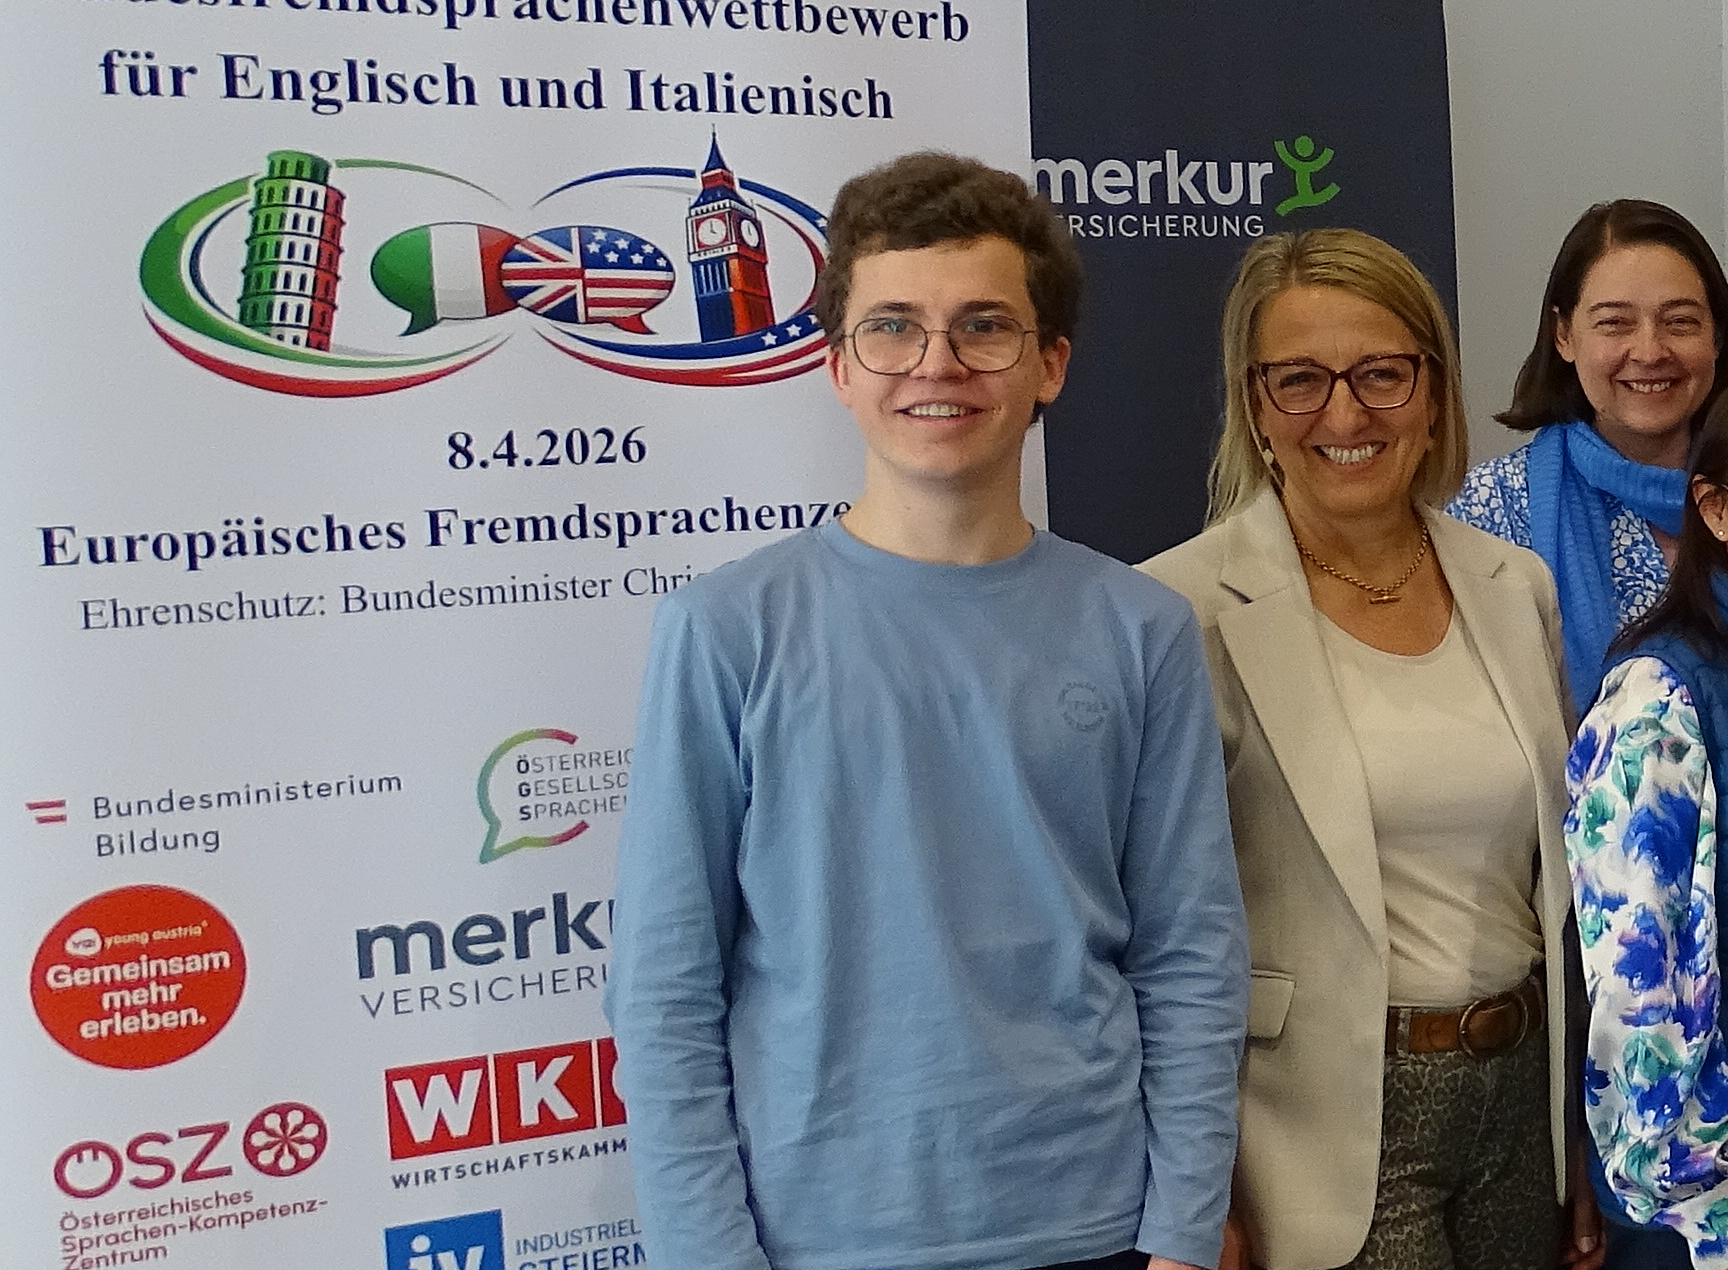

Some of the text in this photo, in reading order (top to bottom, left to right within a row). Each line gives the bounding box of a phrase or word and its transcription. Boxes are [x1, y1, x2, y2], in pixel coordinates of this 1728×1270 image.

[99, 49, 895, 119] für Englisch und Italienisch
[1032, 149, 1273, 205] merkur
[447, 425, 648, 470] 8.4.2026
[36, 511, 407, 572] Europäisches
[80, 565, 710, 630] Ehrenschutz: Bundesminister Chri
[94, 774, 403, 820] Bundesministerium
[519, 795, 627, 821] SPRACHE
[96, 829, 221, 858] Bildung
[46, 951, 231, 990] Gemeinsam
[361, 963, 608, 1019] VERSICHER
[101, 981, 184, 1010] mehr
[79, 1007, 208, 1040] erleben.
[392, 1054, 628, 1144] WK
[60, 1189, 254, 1232] Österreichisches
[61, 1198, 329, 1256] Sprachen-Kompetenz-
